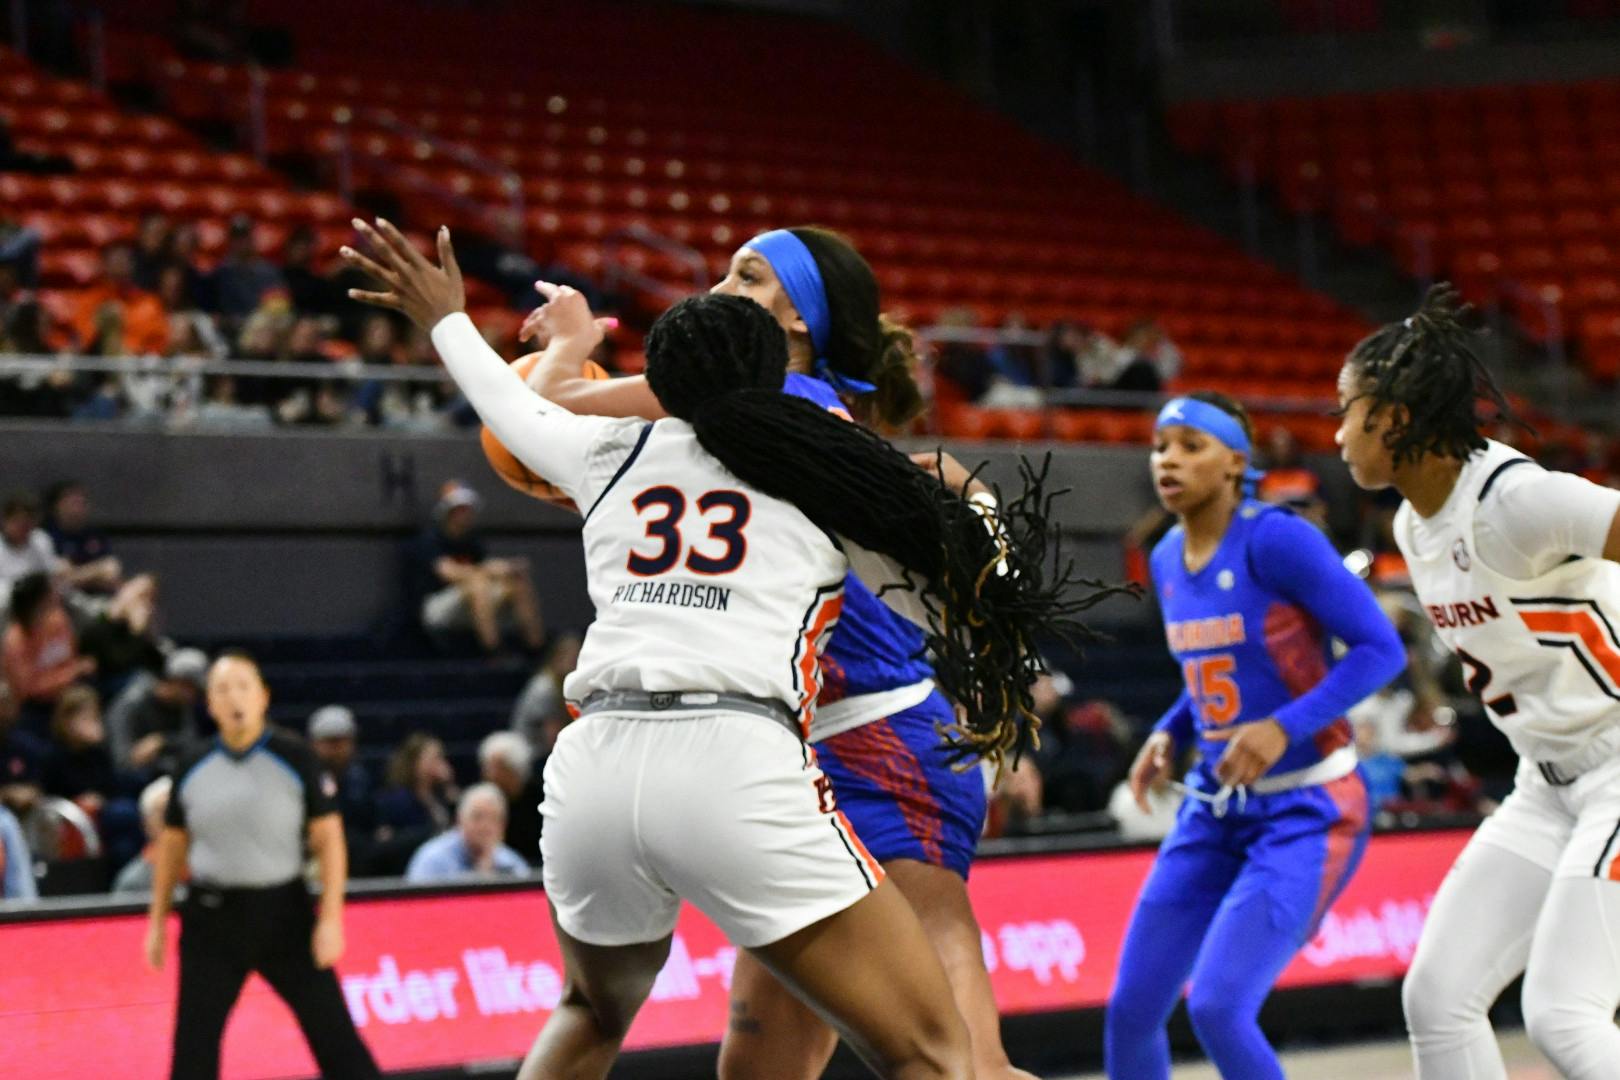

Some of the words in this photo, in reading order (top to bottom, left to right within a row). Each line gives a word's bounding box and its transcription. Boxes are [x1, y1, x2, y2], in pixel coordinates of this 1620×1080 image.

[626, 484, 752, 577] 33
[611, 581, 731, 611] RICHARDSON
[1424, 594, 1501, 629] BURN
[1183, 654, 1242, 726] 15
[342, 954, 459, 1028] rder
[461, 946, 563, 1017] like
[998, 918, 1086, 986] app
